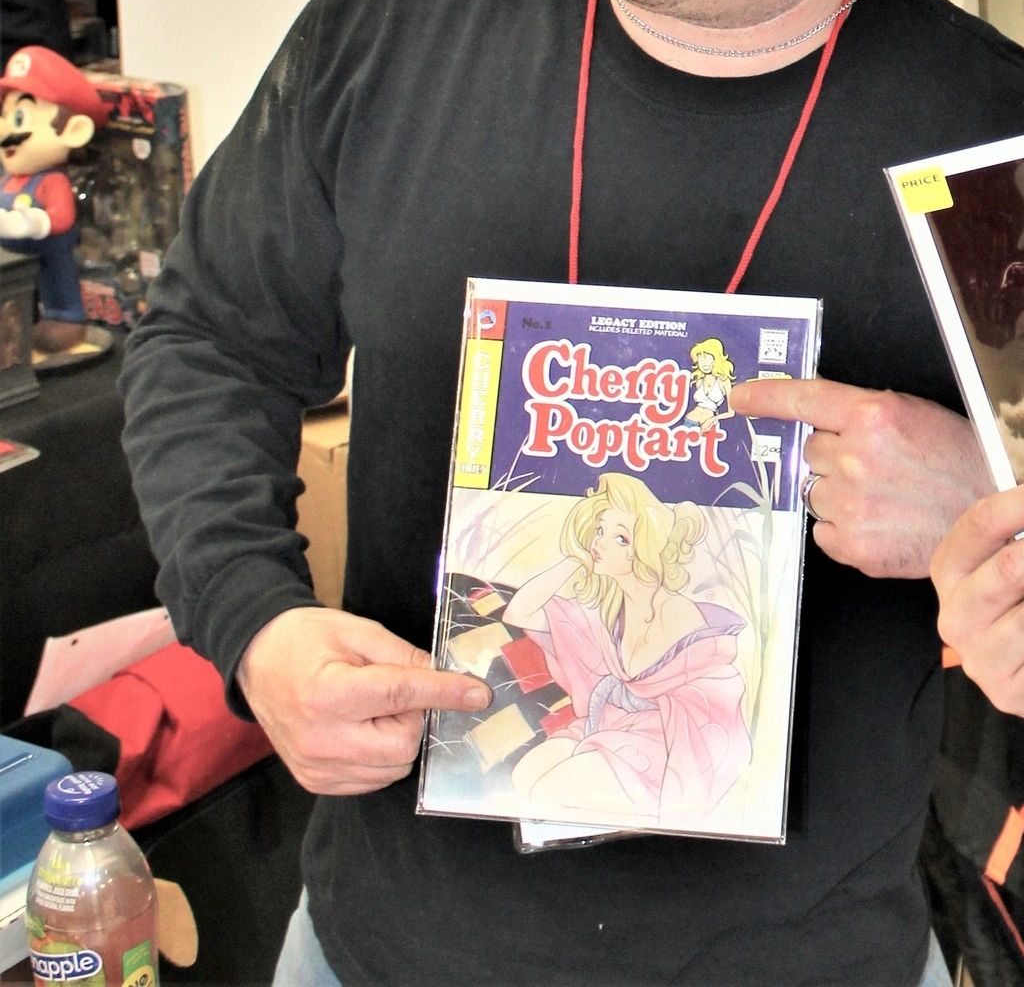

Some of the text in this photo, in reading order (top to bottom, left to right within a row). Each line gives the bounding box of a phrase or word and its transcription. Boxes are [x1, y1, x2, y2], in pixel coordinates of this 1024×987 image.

[902, 174, 941, 189] PRICE
[589, 325, 620, 334] INCLUDES
[622, 328, 653, 336] DELETED
[591, 315, 687, 331] LEGACY EDITION
[526, 341, 688, 425] Cherry
[526, 401, 727, 475] Poptart
